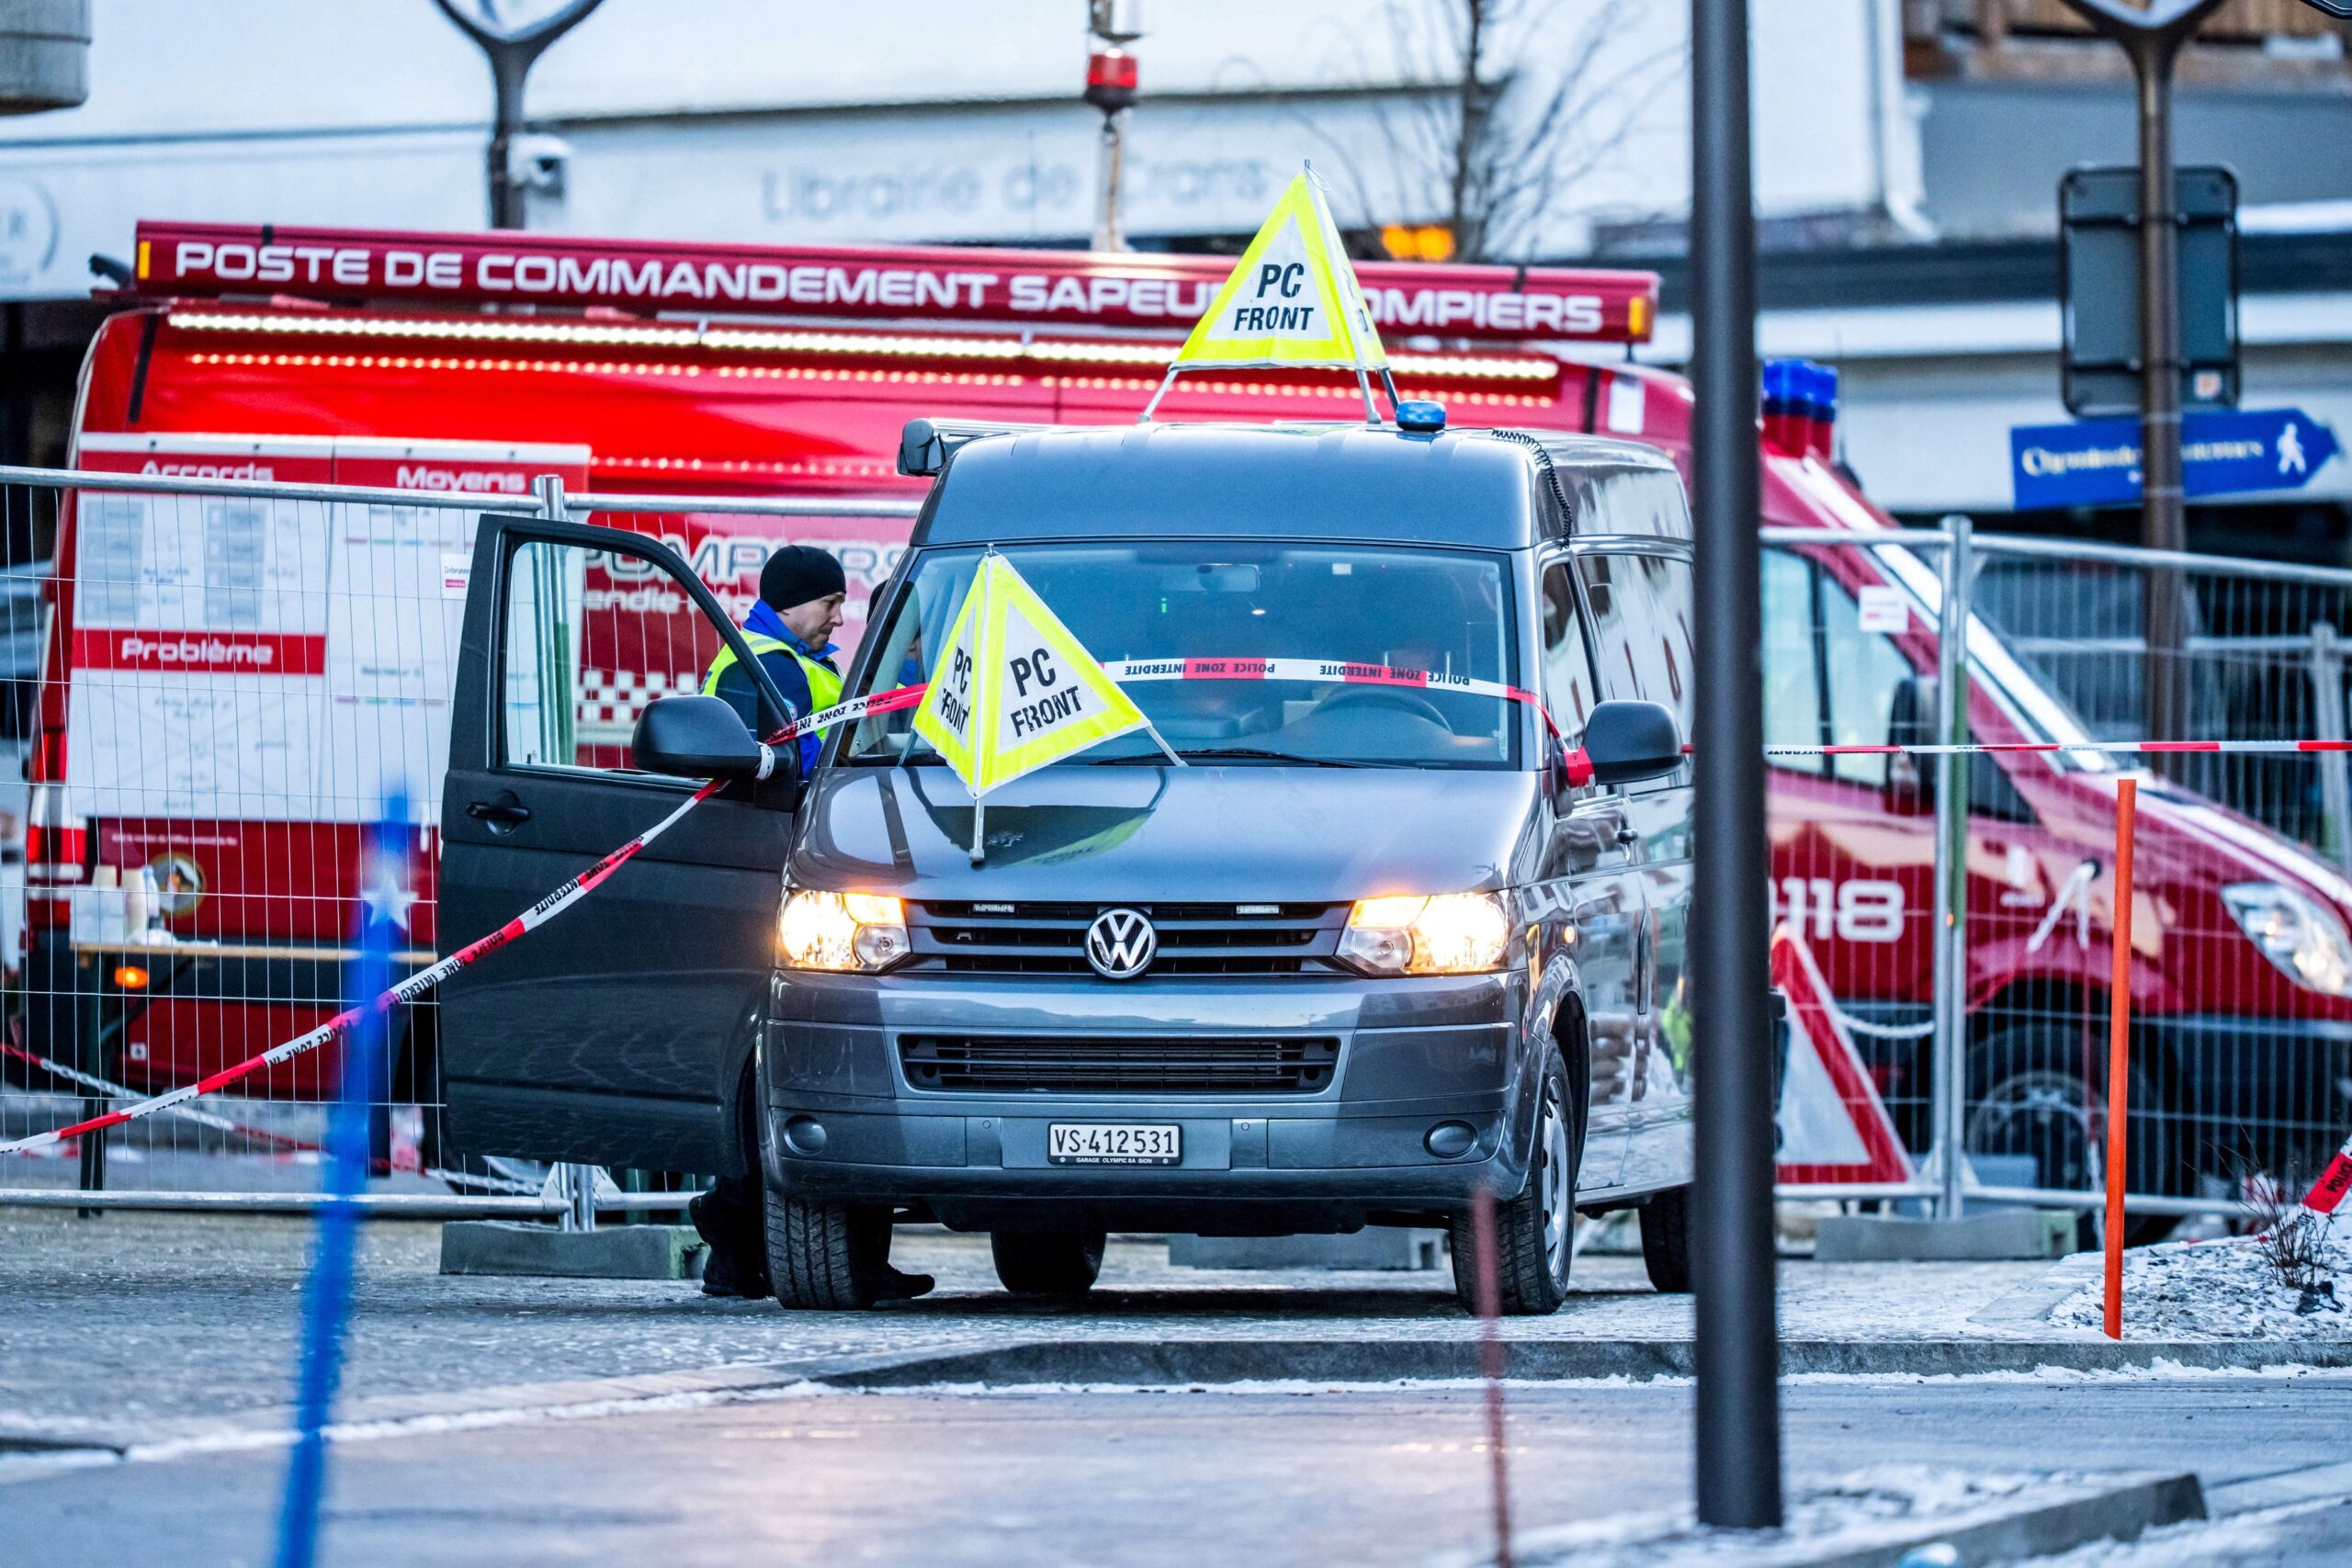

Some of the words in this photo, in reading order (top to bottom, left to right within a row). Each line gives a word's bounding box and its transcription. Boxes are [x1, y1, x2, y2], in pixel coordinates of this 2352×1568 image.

[175, 242, 370, 285] POSTE
[384, 251, 464, 288] DE
[476, 254, 998, 308] COMMANDEMENT
[1009, 276, 1227, 317] SAPEU
[1363, 285, 1603, 333] OMPIERS
[1256, 263, 1305, 299] PC
[1234, 307, 1314, 332] FRONT
[396, 466, 526, 493] Moyens
[121, 637, 274, 665] Problème
[952, 646, 973, 694] PC
[1009, 648, 1057, 697] PC
[1125, 663, 1187, 675] INTERDITE
[1194, 662, 1227, 672] ZONE
[1233, 662, 1275, 673] POLICE
[1319, 665, 1382, 678] INTERDITE
[1389, 669, 1421, 681] ZONE
[1010, 685, 1083, 737] FRONT
[1092, 911, 1153, 974] VW
